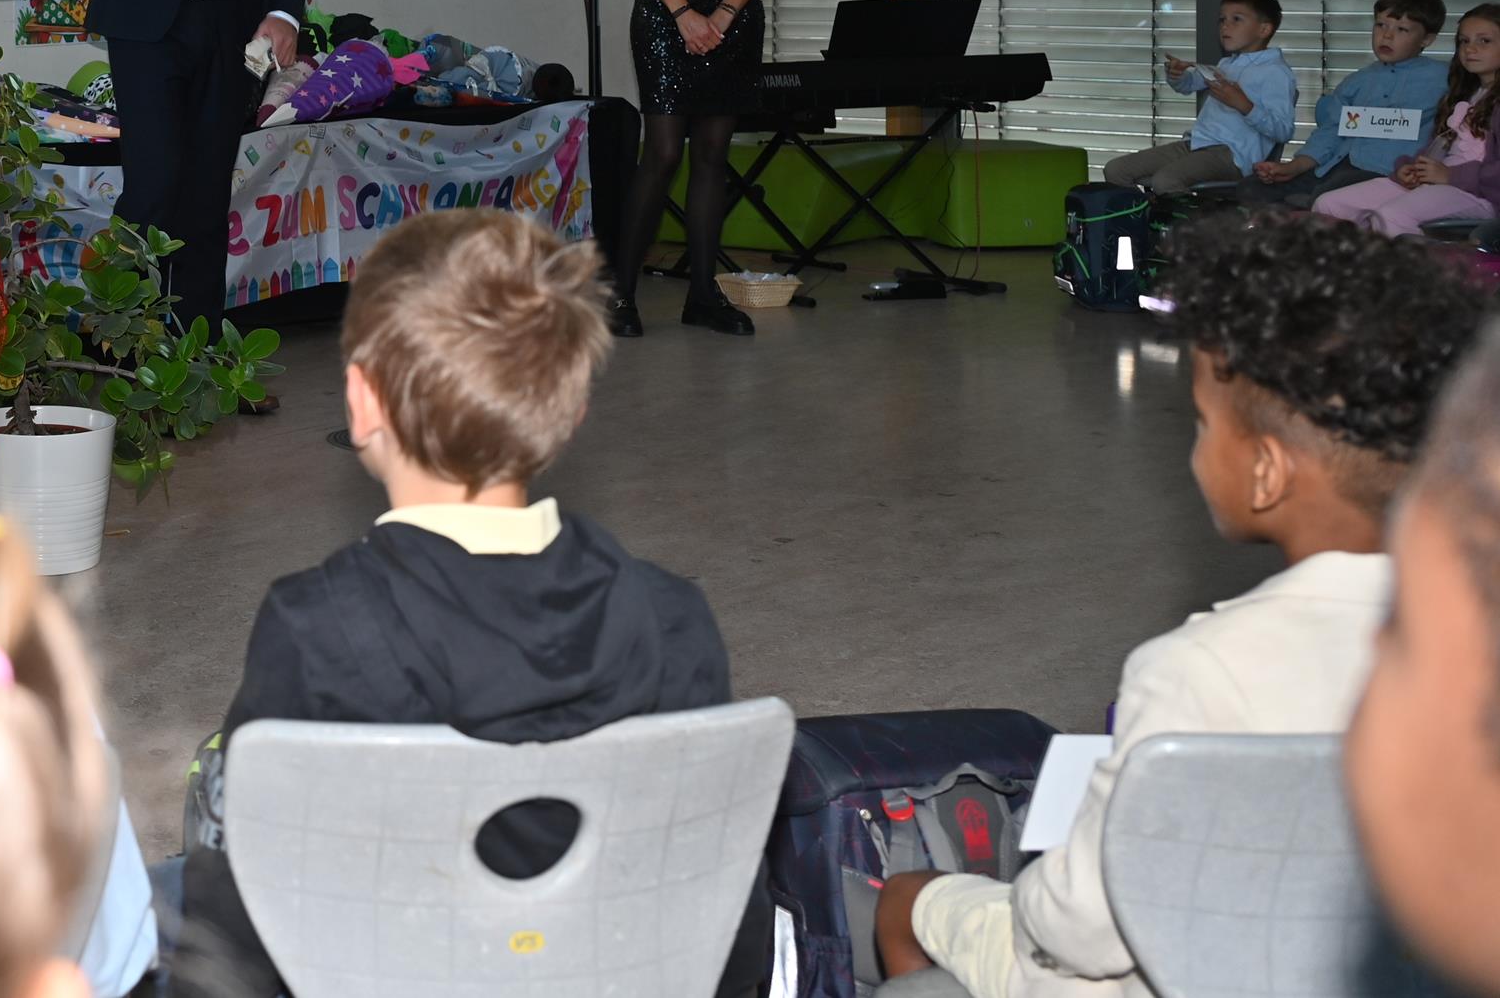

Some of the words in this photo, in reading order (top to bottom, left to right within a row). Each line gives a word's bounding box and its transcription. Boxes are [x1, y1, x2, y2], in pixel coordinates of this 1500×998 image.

[763, 73, 801, 88] YAMAHA
[1370, 115, 1410, 127] Laurin
[255, 185, 328, 248] ZUM
